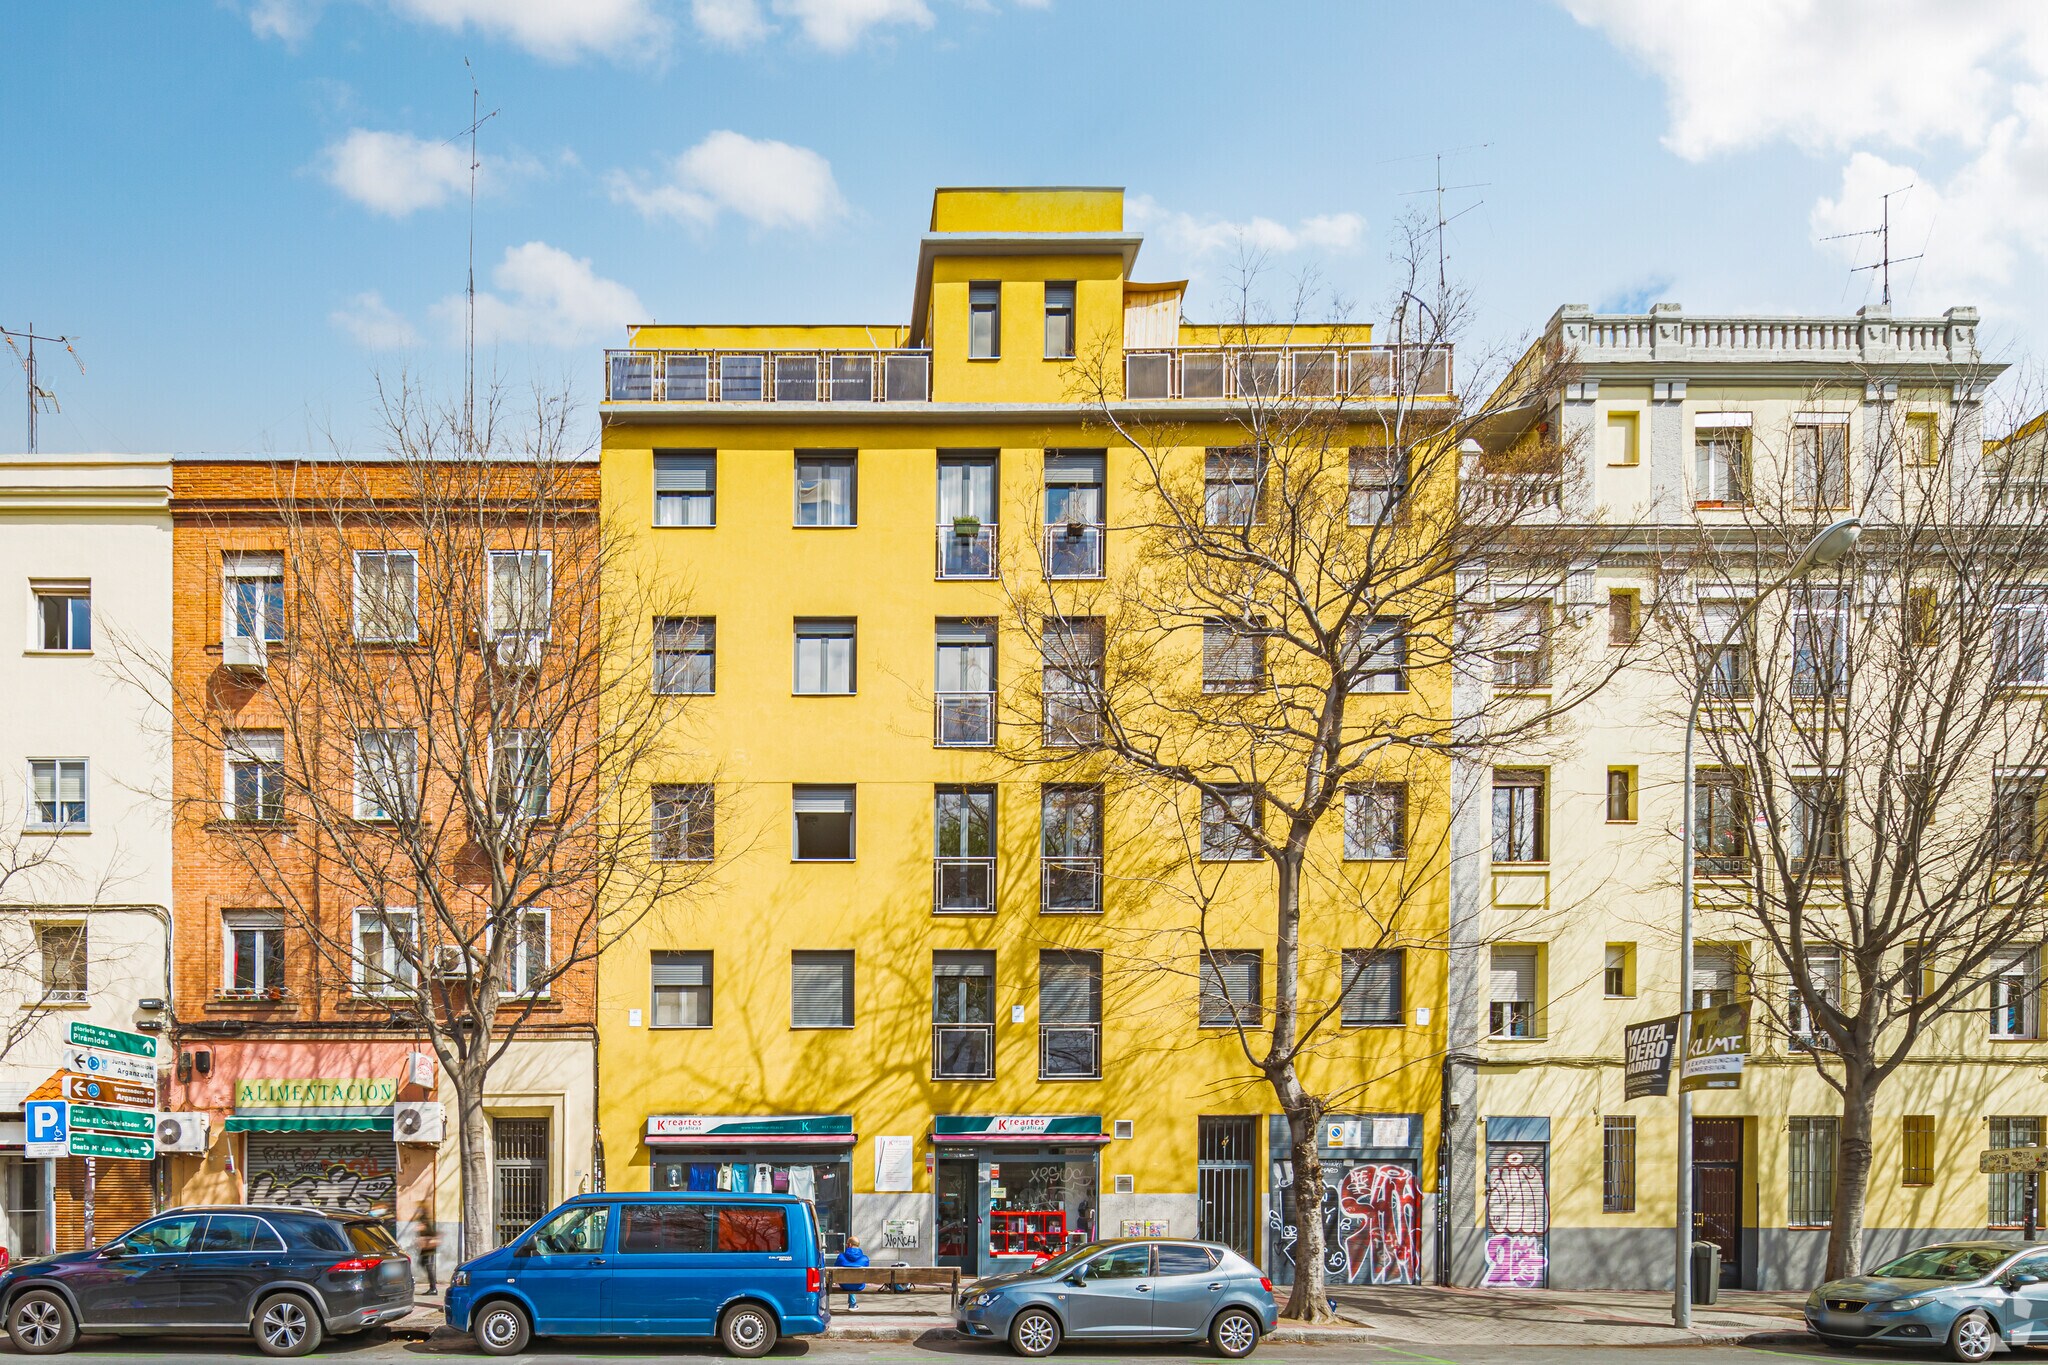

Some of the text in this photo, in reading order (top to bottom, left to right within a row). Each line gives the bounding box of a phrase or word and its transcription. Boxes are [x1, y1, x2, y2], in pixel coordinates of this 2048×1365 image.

[73, 1026, 95, 1035] glorieta
[73, 1033, 109, 1046] Pirámides
[1629, 1040, 1669, 1064] DERO
[130, 1062, 154, 1071] Municipal
[117, 1067, 154, 1079] Arganzuela
[116, 1093, 154, 1104] Arganzuela
[241, 1084, 391, 1101] ALIMENTACION
[34, 1105, 59, 1138] P
[72, 1116, 91, 1124] Jaime
[101, 1119, 140, 1128] Conquistador
